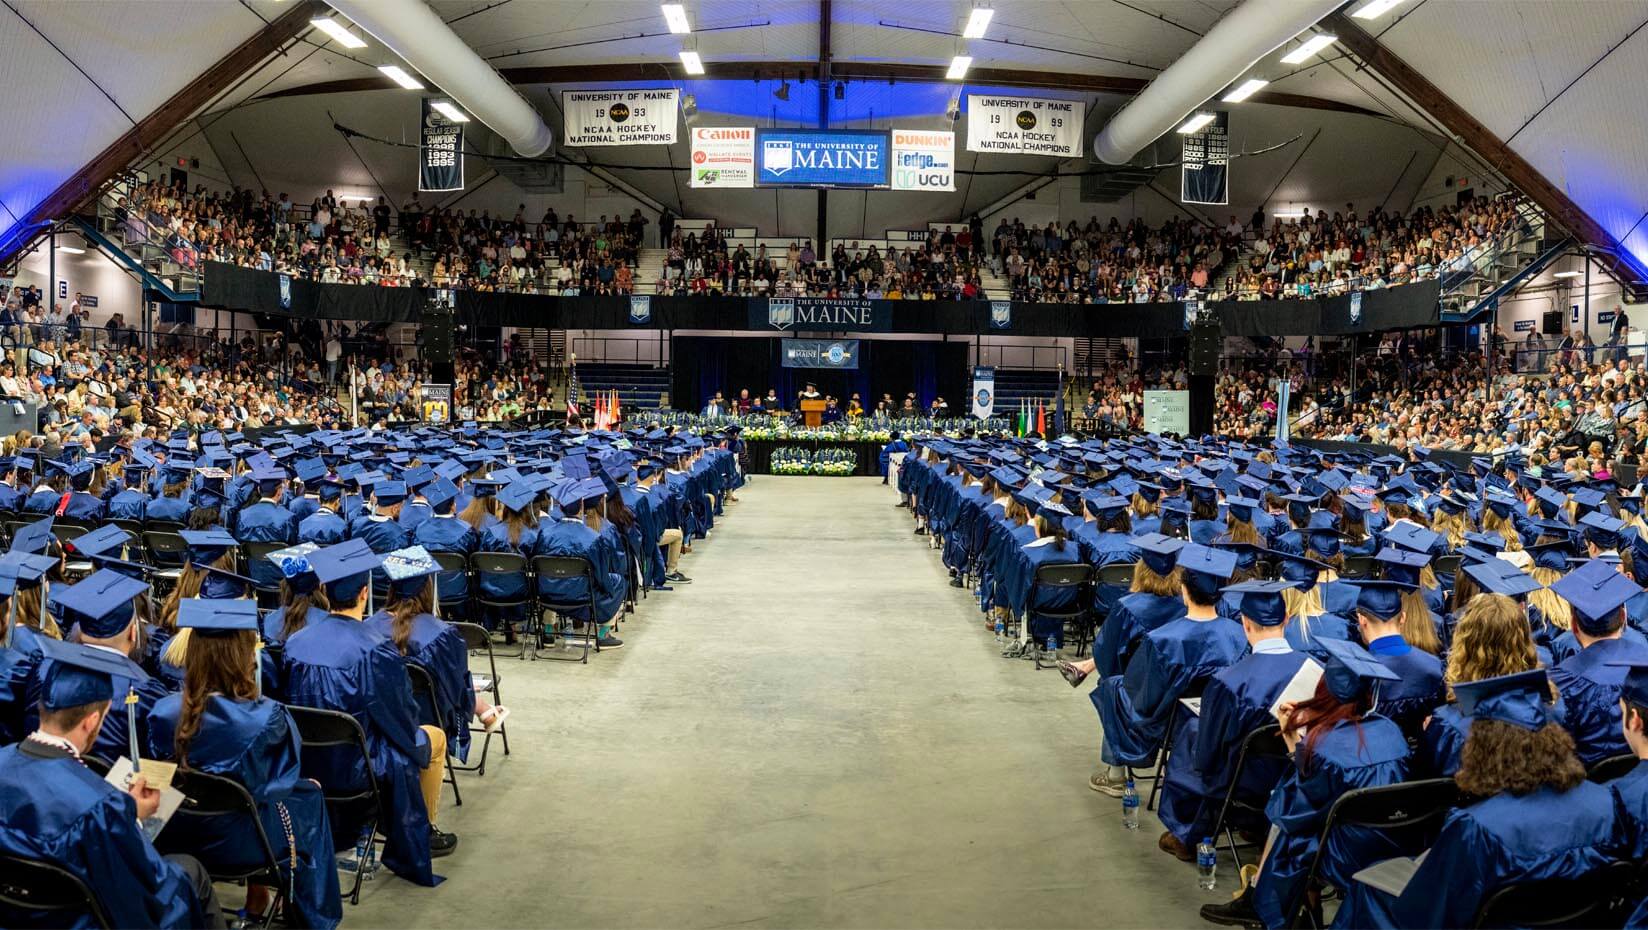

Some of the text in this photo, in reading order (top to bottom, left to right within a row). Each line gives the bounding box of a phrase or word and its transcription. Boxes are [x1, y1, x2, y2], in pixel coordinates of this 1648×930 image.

[571, 93, 623, 101] UNIVERSITY
[982, 99, 1072, 111] UNIVERSITY OF MAINE
[596, 109, 605, 118] 19
[634, 108, 646, 117] 93
[991, 114, 1001, 123] 19
[1051, 118, 1063, 127] 99
[584, 124, 656, 134] NCAA HOCKEY
[697, 129, 750, 139] Canon
[427, 134, 456, 144] CHAMPIONS
[570, 134, 671, 143] NATIONAL CHAMPIONS
[896, 135, 951, 146] DUNKIN'
[996, 131, 1056, 142] NCAA HOCKEY
[981, 141, 1070, 153] NATIONAL CHAMPIONS
[429, 151, 454, 159] 1993
[794, 150, 879, 169] MAINE
[428, 158, 455, 167] 1995
[919, 174, 949, 187] UCU
[795, 306, 872, 324] MAINE
